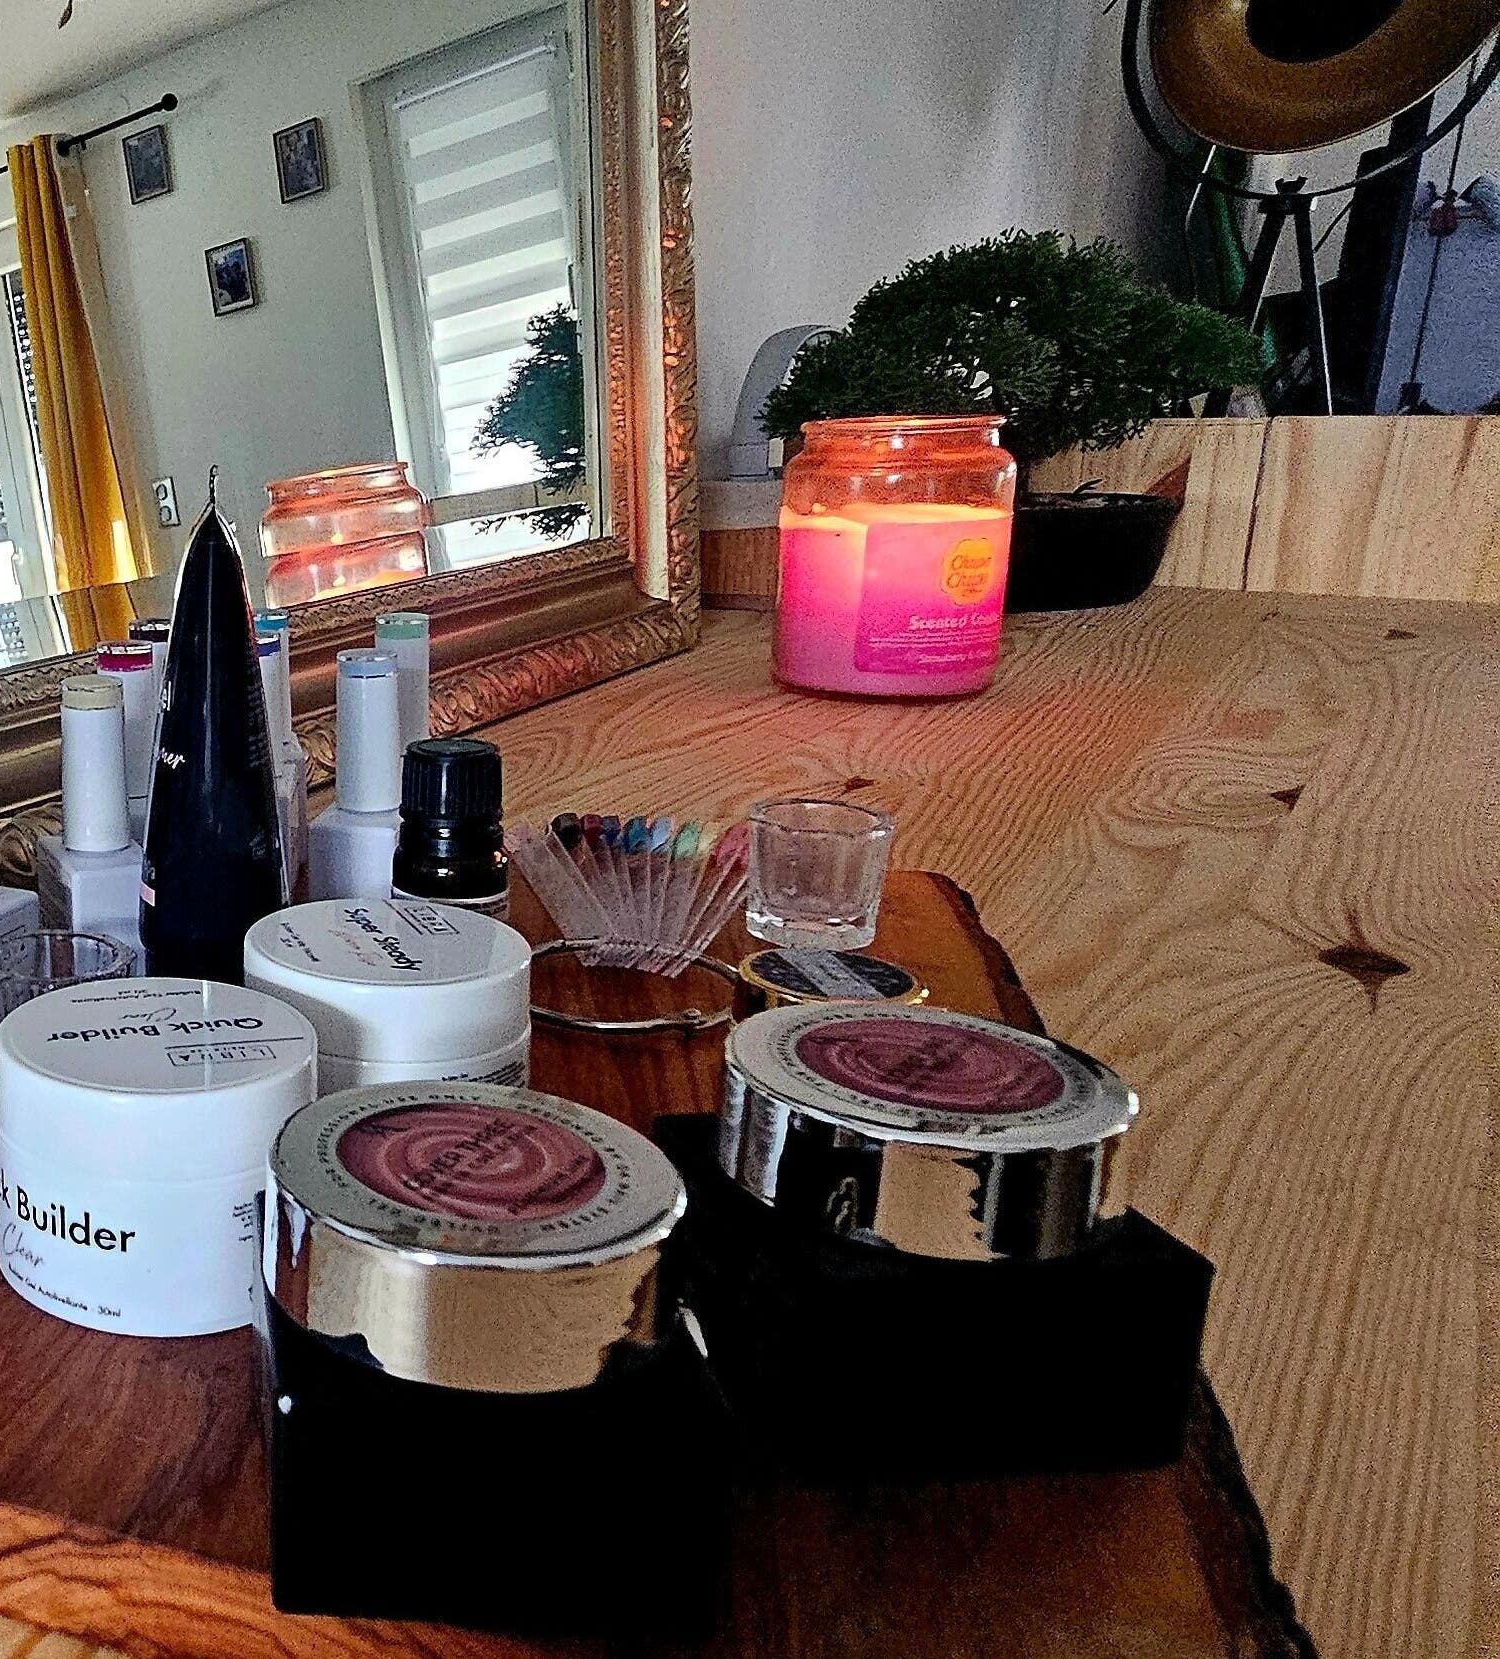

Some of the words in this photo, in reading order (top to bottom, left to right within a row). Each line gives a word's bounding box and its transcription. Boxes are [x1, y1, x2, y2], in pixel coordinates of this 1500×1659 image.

[343, 907, 383, 934] Super
[373, 935, 423, 971] Steady
[47, 1025, 161, 1043] Builder
[168, 1017, 264, 1034] Quick
[16, 1185, 136, 1253] Builder
[2, 1222, 45, 1268] Clear
